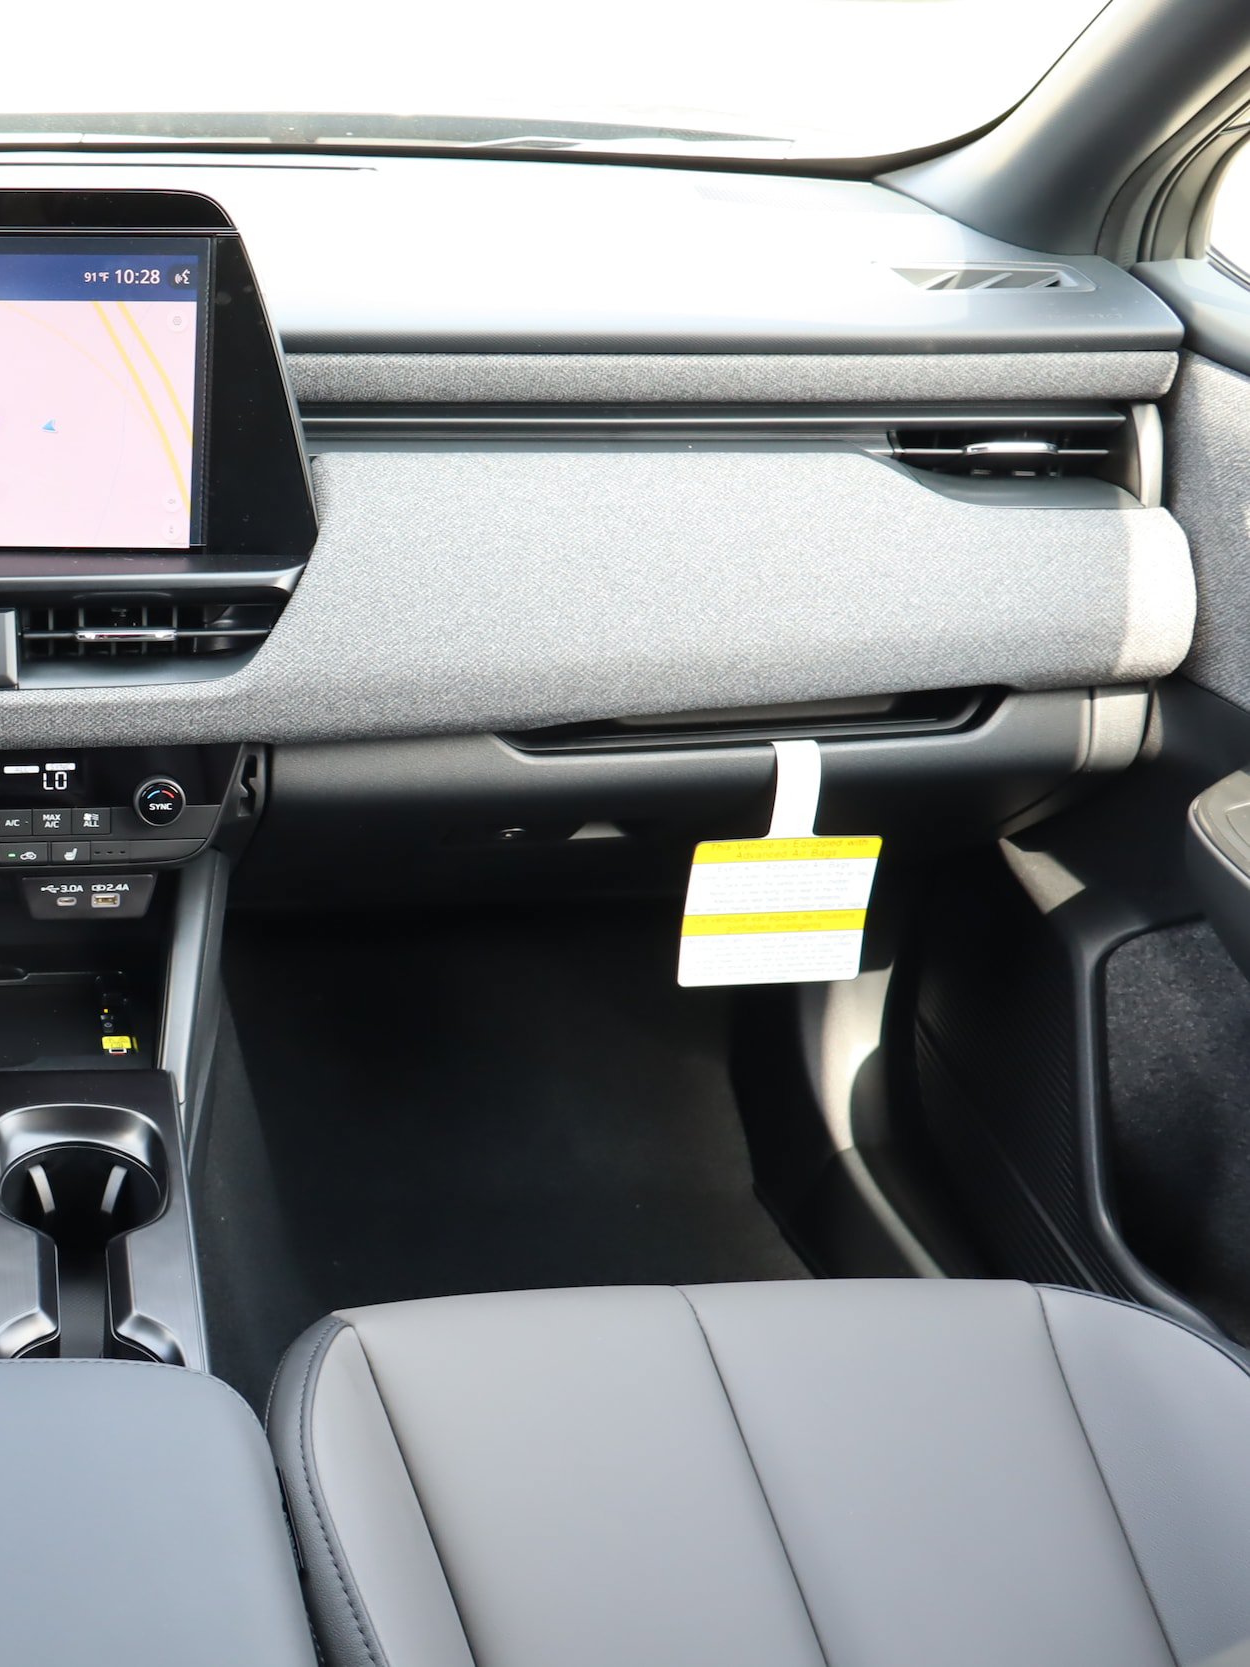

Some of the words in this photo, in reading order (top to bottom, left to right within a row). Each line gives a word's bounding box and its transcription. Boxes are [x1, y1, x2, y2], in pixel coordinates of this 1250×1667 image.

[114, 269, 161, 285] 10:28
[42, 771, 68, 790] LO
[149, 803, 173, 811] SYNC
[42, 813, 61, 821] MAX
[4, 818, 21, 827] A/C
[44, 820, 60, 829] A/C
[83, 820, 100, 828] ALL
[60, 884, 84, 893] 3.0A
[105, 883, 130, 892] 2.4A
